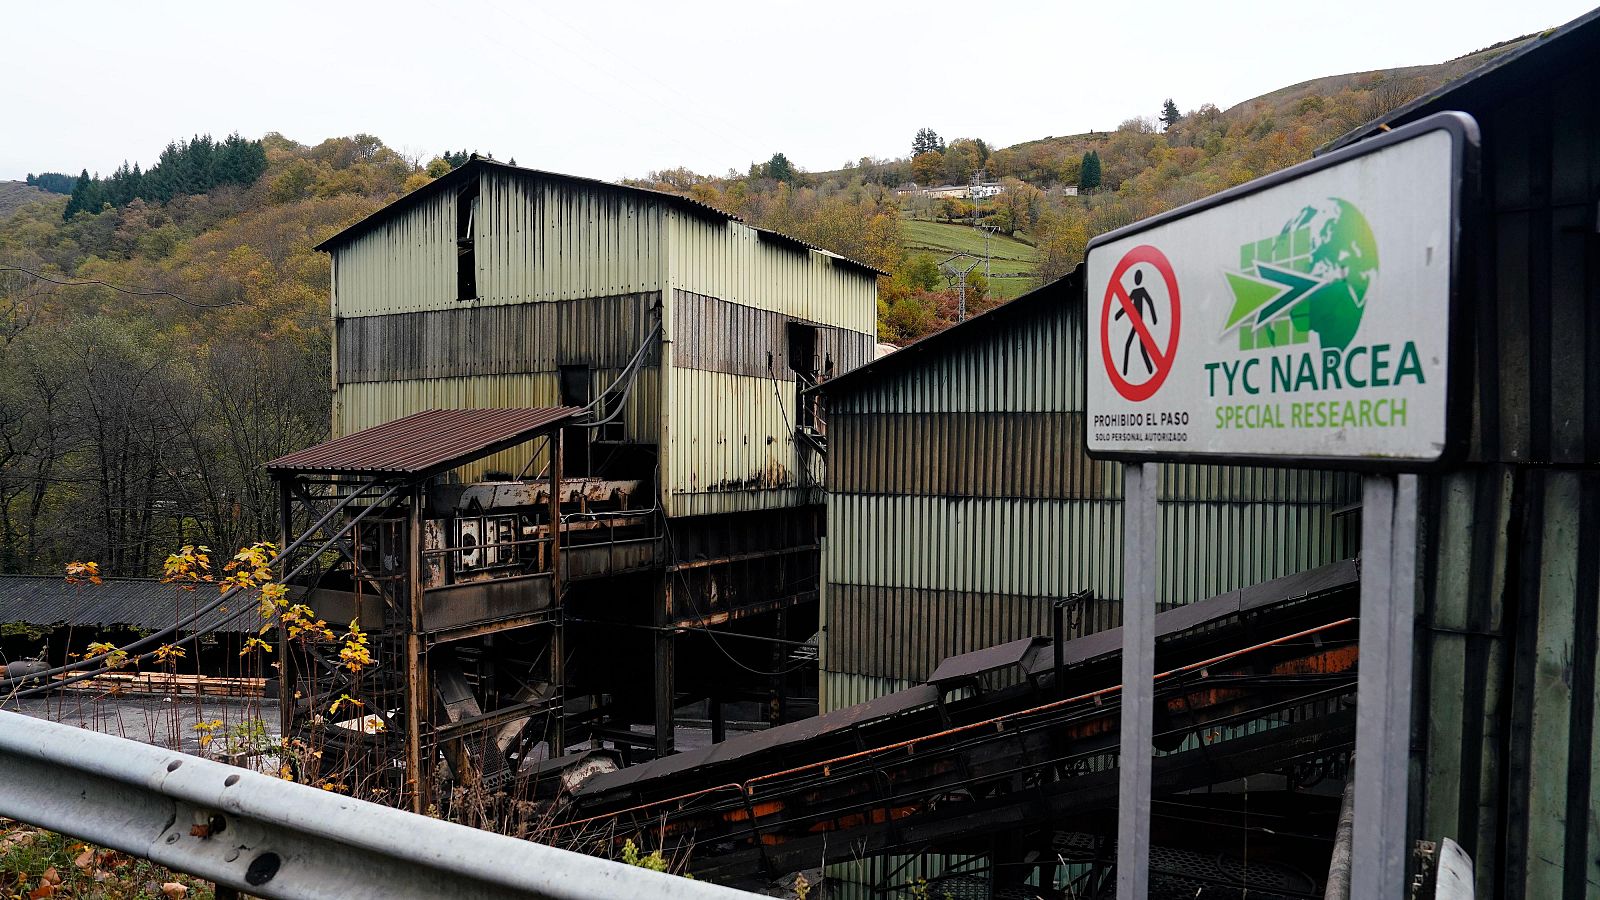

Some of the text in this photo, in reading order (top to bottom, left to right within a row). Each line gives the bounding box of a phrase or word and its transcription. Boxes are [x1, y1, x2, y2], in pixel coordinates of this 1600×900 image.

[1204, 341, 1426, 397] TYC NARCEA
[1094, 411, 1189, 427] PROHIBIDO EL PASO
[1215, 398, 1407, 429] SPECIAL RESEARCH
[1095, 432, 1187, 441] SOLO PERSONAL AUTORIZADO
